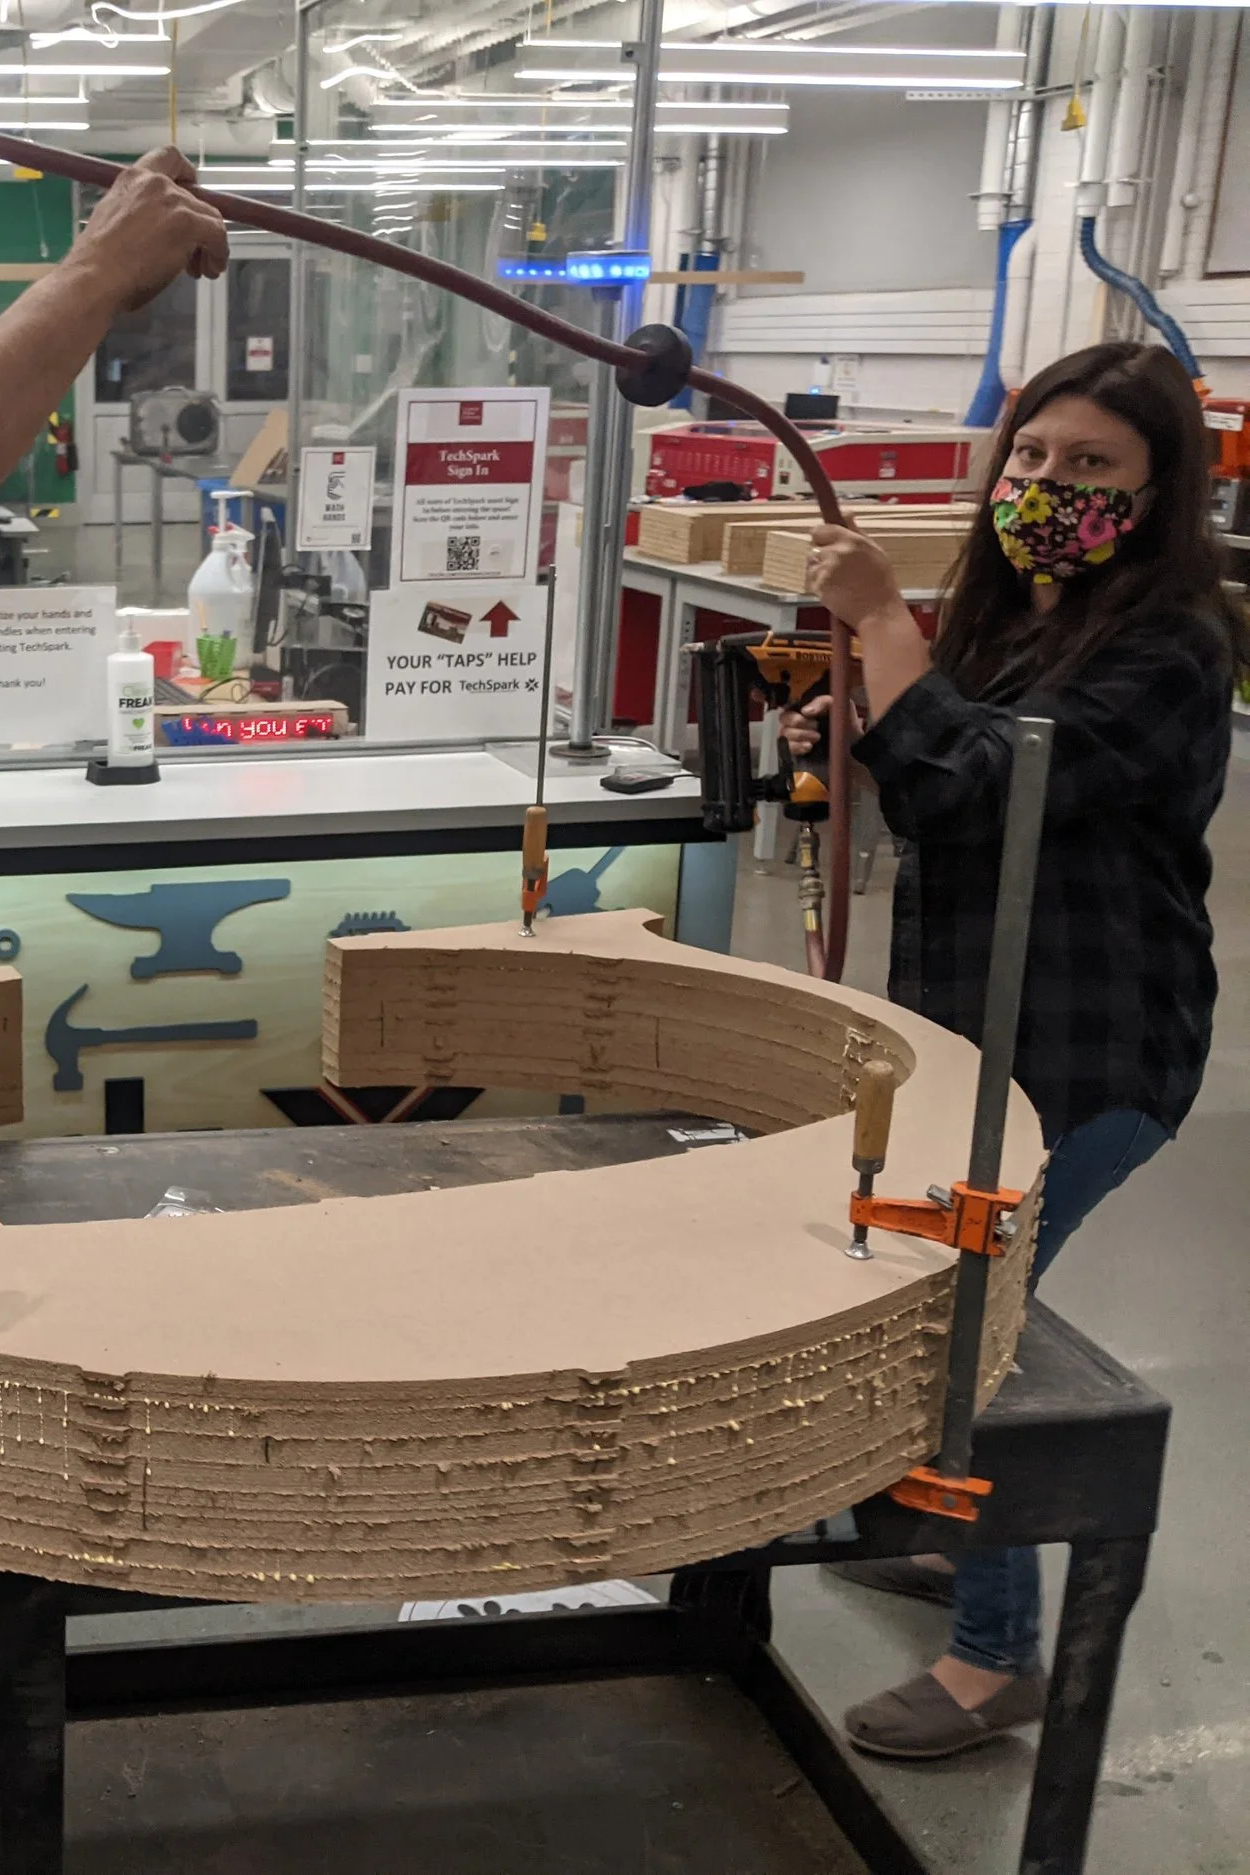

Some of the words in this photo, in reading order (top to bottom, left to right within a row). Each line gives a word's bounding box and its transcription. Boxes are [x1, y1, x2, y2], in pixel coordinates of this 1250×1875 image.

[438, 449, 500, 464] TechSpark
[447, 464, 473, 479] Sign
[476, 464, 489, 476] In
[17, 612, 39, 621] your
[41, 610, 71, 619] hands
[74, 609, 92, 618] and
[26, 626, 53, 635] when
[55, 626, 96, 636] entering
[387, 655, 432, 670] YOUR
[498, 652, 537, 667] HELP
[24, 677, 46, 689] you!
[385, 681, 416, 696] PAY
[421, 680, 452, 695] FOR
[459, 679, 520, 693] TechSpark
[240, 719, 288, 739] you
